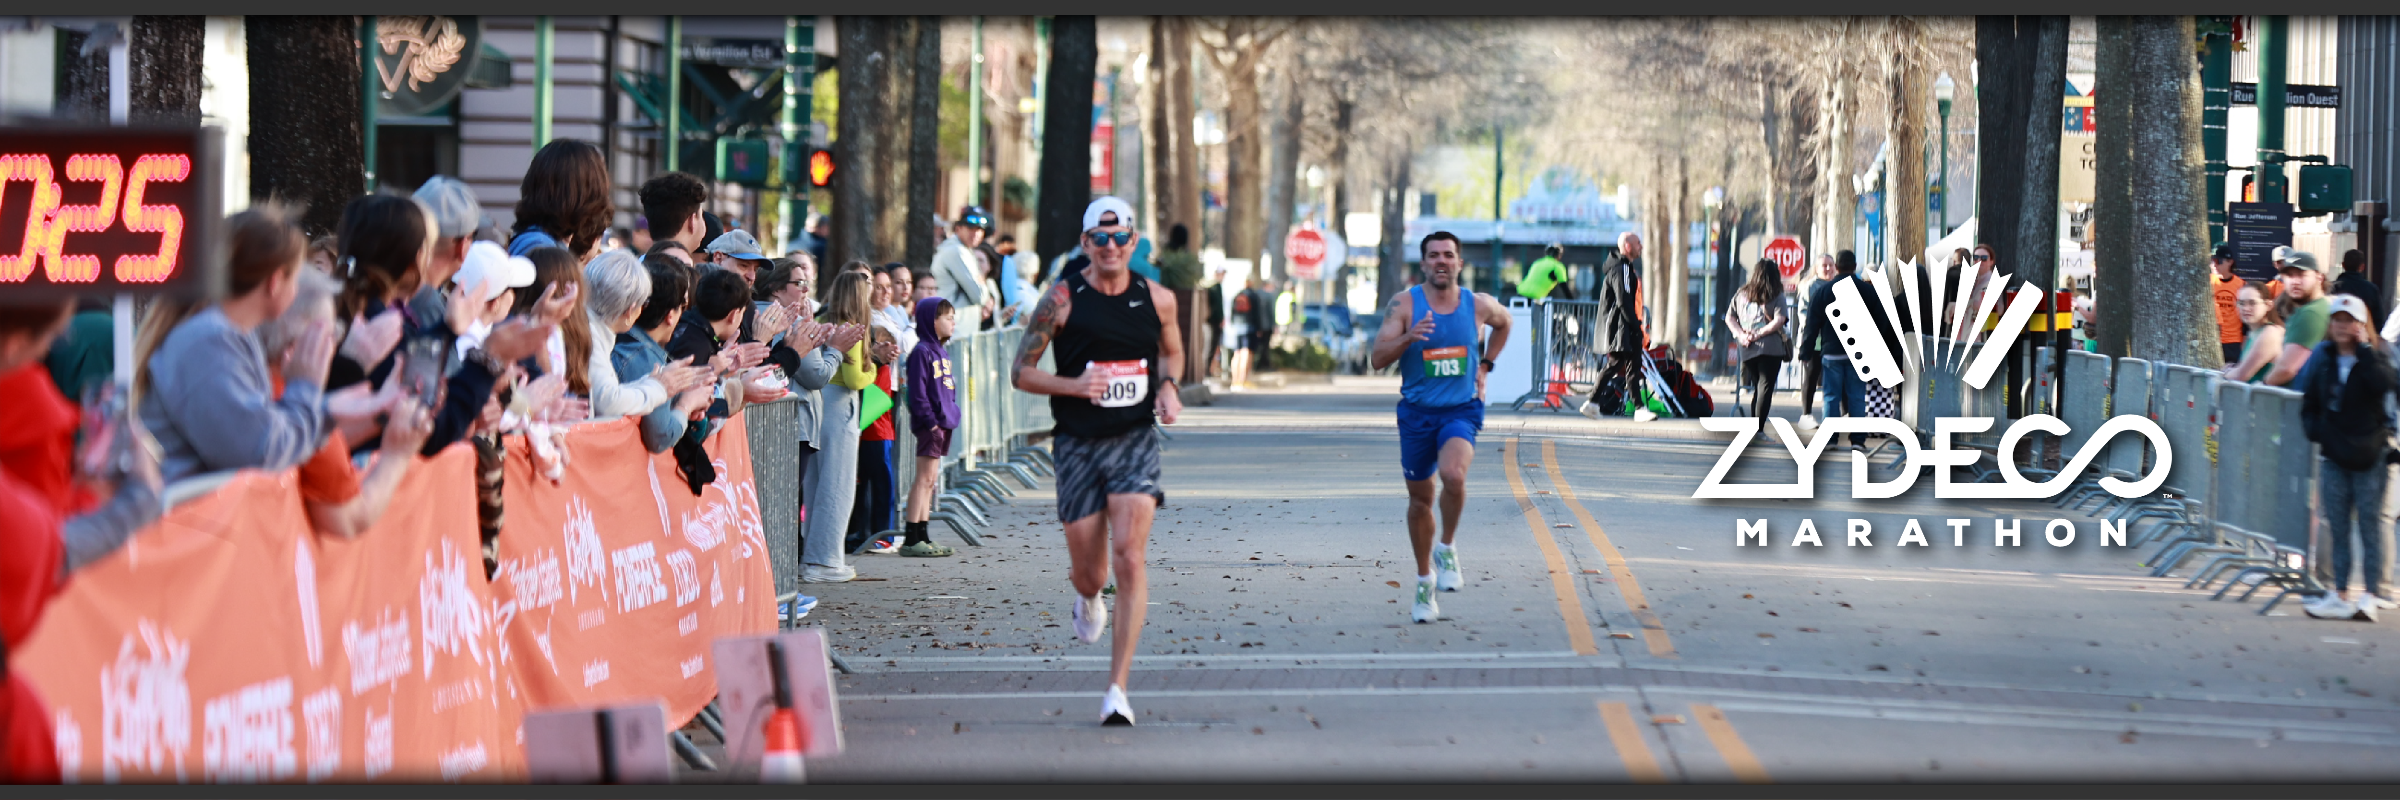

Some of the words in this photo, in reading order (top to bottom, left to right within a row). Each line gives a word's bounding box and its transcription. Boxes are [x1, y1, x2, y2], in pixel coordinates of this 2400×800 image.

[2234, 89, 2254, 102] Rue
[2307, 92, 2339, 106] Ouest
[1289, 238, 1324, 259] STOP
[1766, 247, 1801, 268] STOP
[1431, 359, 1460, 377] 703
